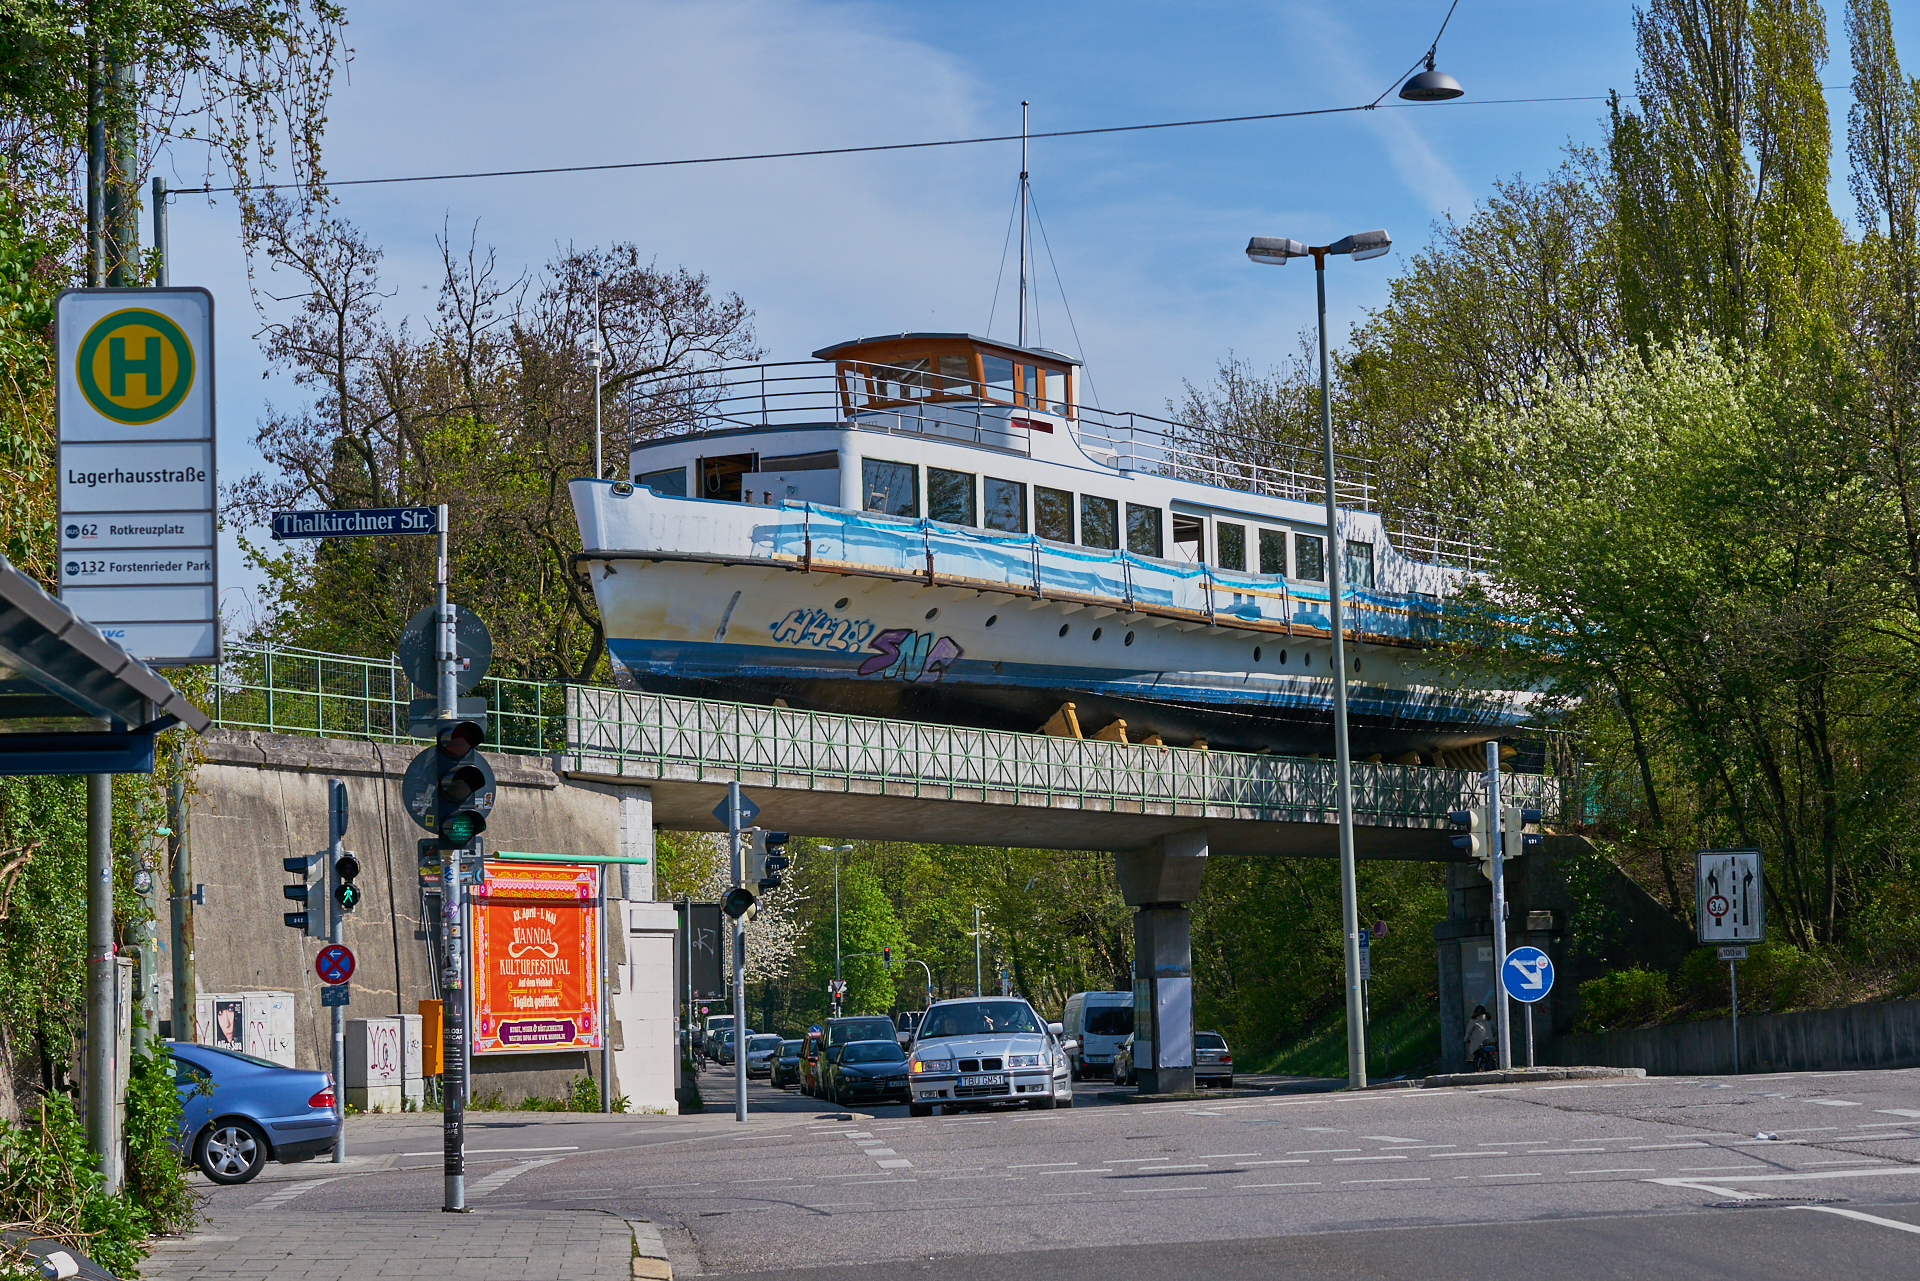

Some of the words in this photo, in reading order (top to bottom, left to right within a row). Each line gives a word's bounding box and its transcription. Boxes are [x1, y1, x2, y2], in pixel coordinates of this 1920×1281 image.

[109, 336, 162, 397] H
[69, 466, 206, 488] Lagerhausstraße
[280, 512, 396, 533] Thalkirchner
[401, 510, 430, 529] Str.
[81, 524, 98, 536] 62
[110, 524, 185, 537] Rotkreuzplatz
[81, 561, 105, 573] 132
[110, 561, 183, 573] Forstenrieder
[186, 560, 211, 571] Park
[522, 907, 536, 920] April
[513, 927, 552, 944] WANNDA
[1723, 949, 1735, 957] 100
[500, 958, 571, 976] KULTURFESTIVAL
[513, 995, 533, 1009] Täglich
[963, 1077, 980, 1086] TBU
